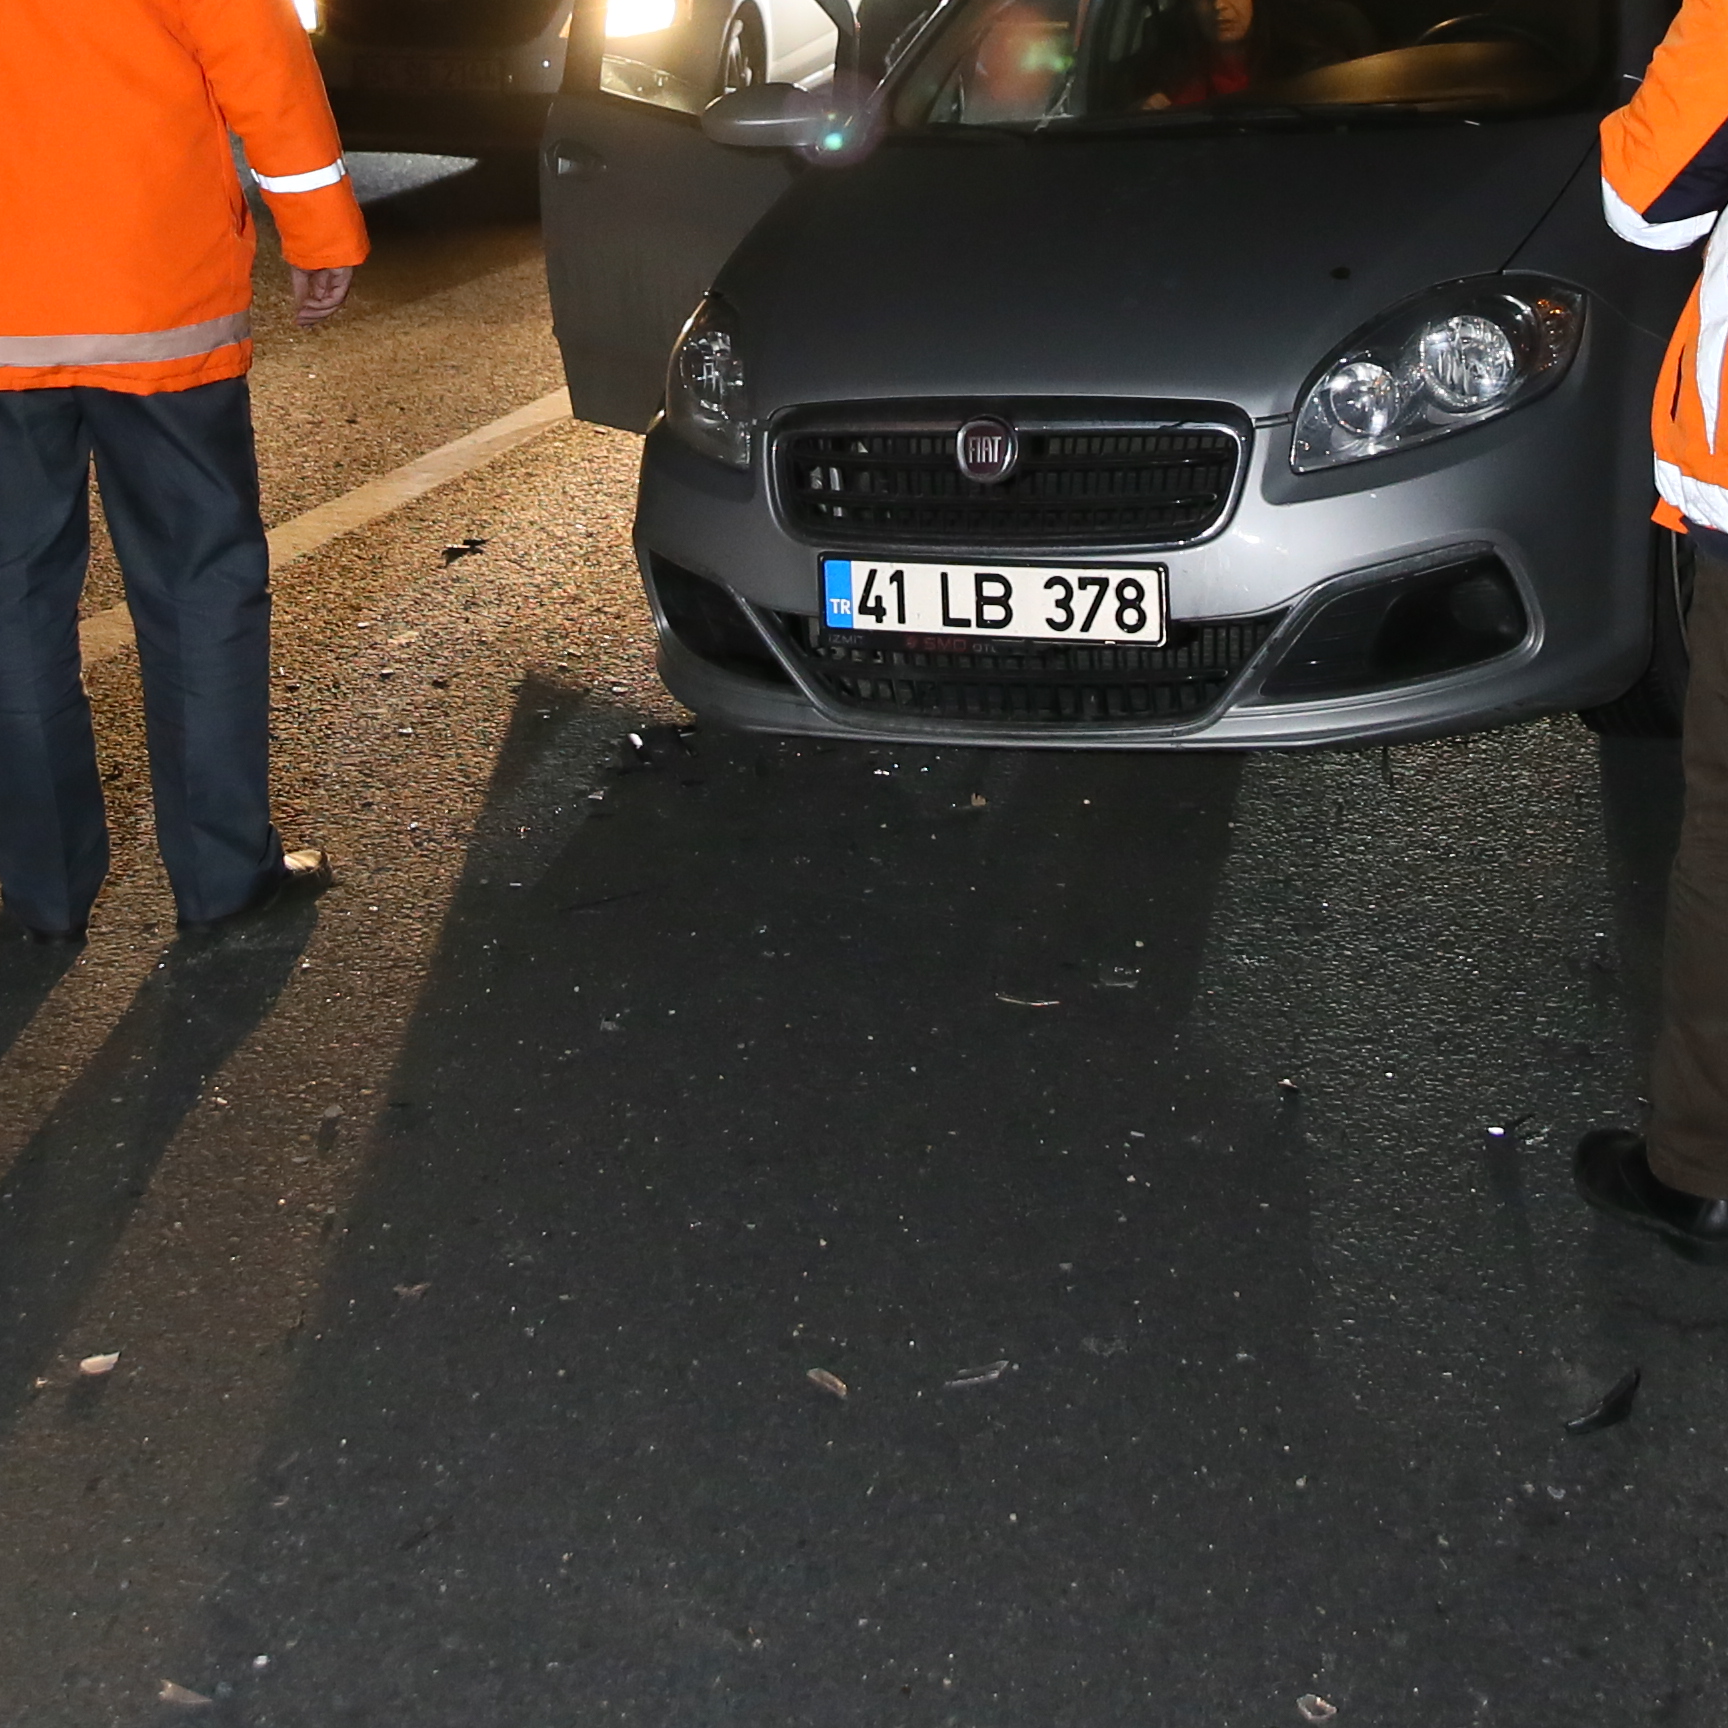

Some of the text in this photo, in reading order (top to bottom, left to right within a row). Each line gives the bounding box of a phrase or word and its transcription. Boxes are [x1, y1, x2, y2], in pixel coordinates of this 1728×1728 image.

[968, 436, 1002, 463] FIAT
[829, 568, 1148, 634] TR 41 LB 378
